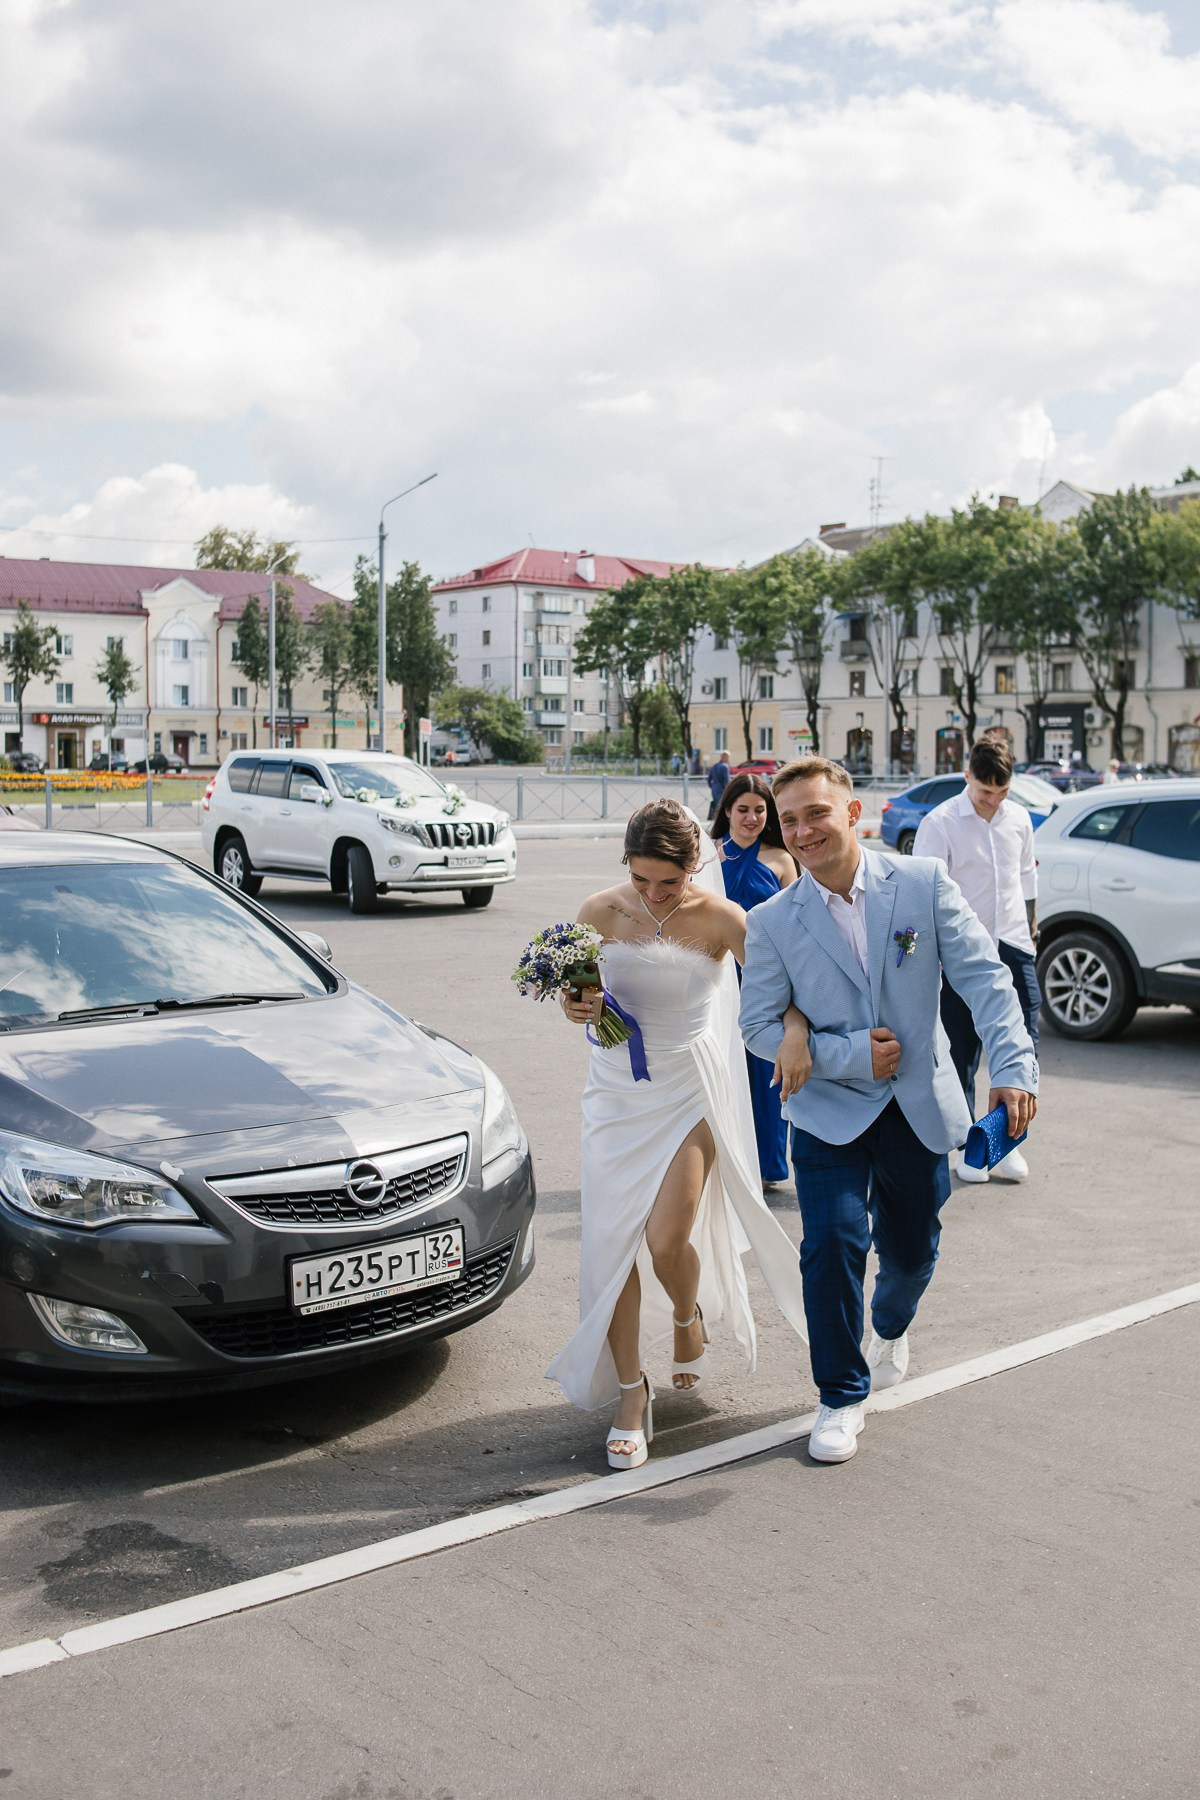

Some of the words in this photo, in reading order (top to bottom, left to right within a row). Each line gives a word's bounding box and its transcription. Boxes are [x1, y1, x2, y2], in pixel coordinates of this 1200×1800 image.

[51, 714, 73, 724] ДОДО
[74, 713, 101, 724] ПИЦЦА
[305, 1249, 420, 1298] Н235РТ
[428, 1233, 454, 1261] 32
[428, 1261, 447, 1272] RUS
